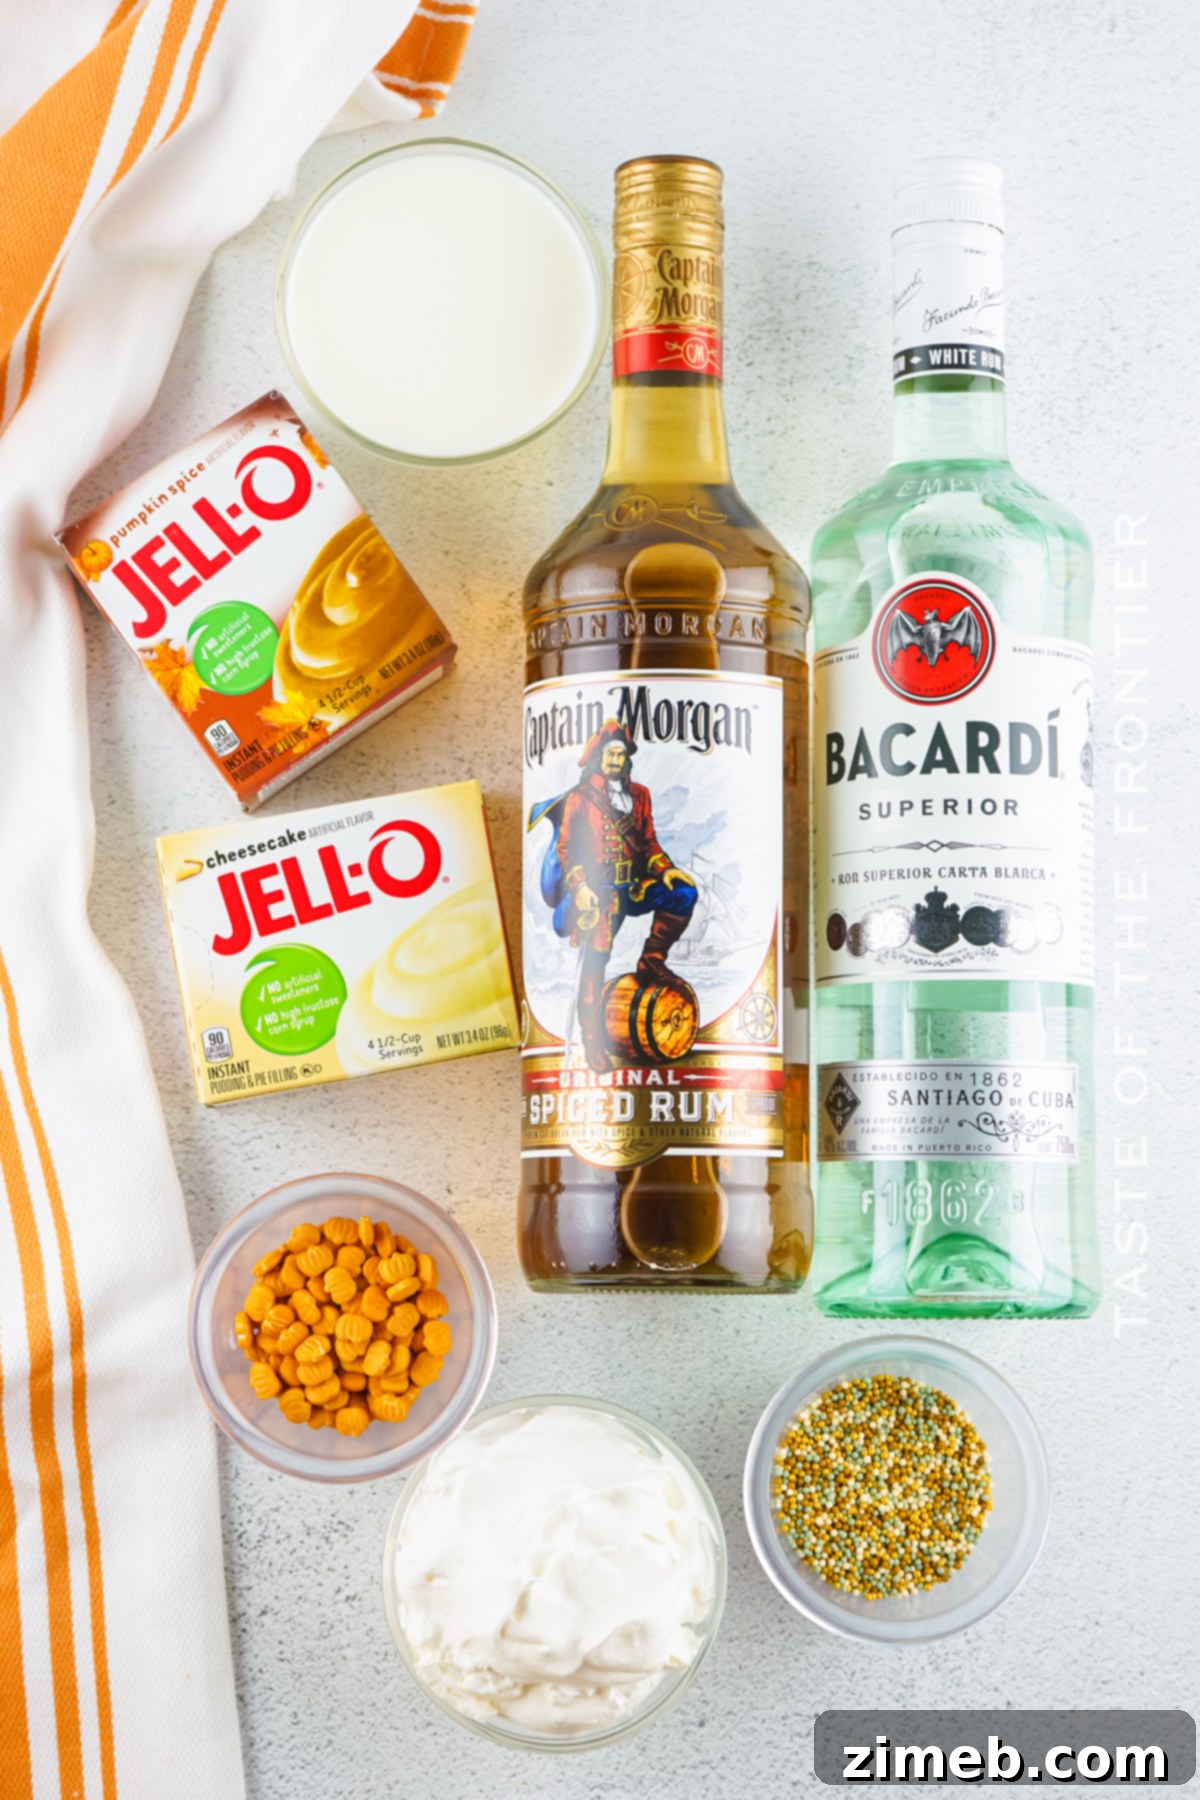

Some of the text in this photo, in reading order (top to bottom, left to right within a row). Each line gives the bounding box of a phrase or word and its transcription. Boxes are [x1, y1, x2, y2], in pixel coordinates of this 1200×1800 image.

[657, 249, 719, 288] Captai
[653, 287, 719, 323] Morga
[928, 348, 978, 367] WHITE
[109, 492, 169, 549] pumpkin
[168, 460, 206, 496] spice
[111, 445, 313, 638] JELL-O
[205, 637, 218, 651] NO
[325, 675, 366, 704] 1/2-Cup
[332, 684, 373, 714] Servings
[210, 724, 228, 741] 90
[525, 686, 753, 770] Captain Morgan
[222, 739, 264, 773] INSTANT
[826, 706, 1061, 786] BACARDÍ
[858, 797, 1019, 820] SUPERIOR
[206, 810, 375, 869] cheesecake ARTIFICIAL FLAVOR
[863, 866, 933, 881] SUPERIOR
[938, 866, 988, 879] CARTA
[994, 866, 1047, 880] BLANCA
[212, 819, 442, 956] JELL-O
[266, 968, 322, 995] NO artificial
[271, 983, 320, 1005] sweeteners
[264, 997, 339, 1026] NO high fructose
[268, 1015, 315, 1036] corn syrup
[207, 1031, 225, 1047] 90
[368, 1032, 422, 1049] 4 1/2-Cup
[436, 1034, 451, 1049] NET
[450, 1031, 464, 1046] WT
[465, 1029, 479, 1044] 3.4
[478, 1026, 490, 1041] OZ
[378, 1044, 424, 1060] Servings
[207, 1060, 250, 1080] INSTANT
[209, 1075, 247, 1095] PUDDING
[247, 1074, 255, 1088] &
[254, 1072, 268, 1087] PIE
[267, 1065, 298, 1085] FILLING
[559, 1069, 682, 1088] ORIGINAL
[852, 1071, 1022, 1088] ESTABLECIDO EN 1862
[529, 1091, 635, 1125] SPICED
[649, 1091, 739, 1123] RUM
[887, 1089, 1074, 1109] SANTIAGO DE CUBA
[921, 1116, 933, 1124] DE
[938, 1116, 950, 1124] LA
[902, 1144, 913, 1152] IN
[918, 1144, 961, 1152] PUERTO
[965, 1144, 992, 1152] RICO
[881, 1178, 1002, 1227] 1862
